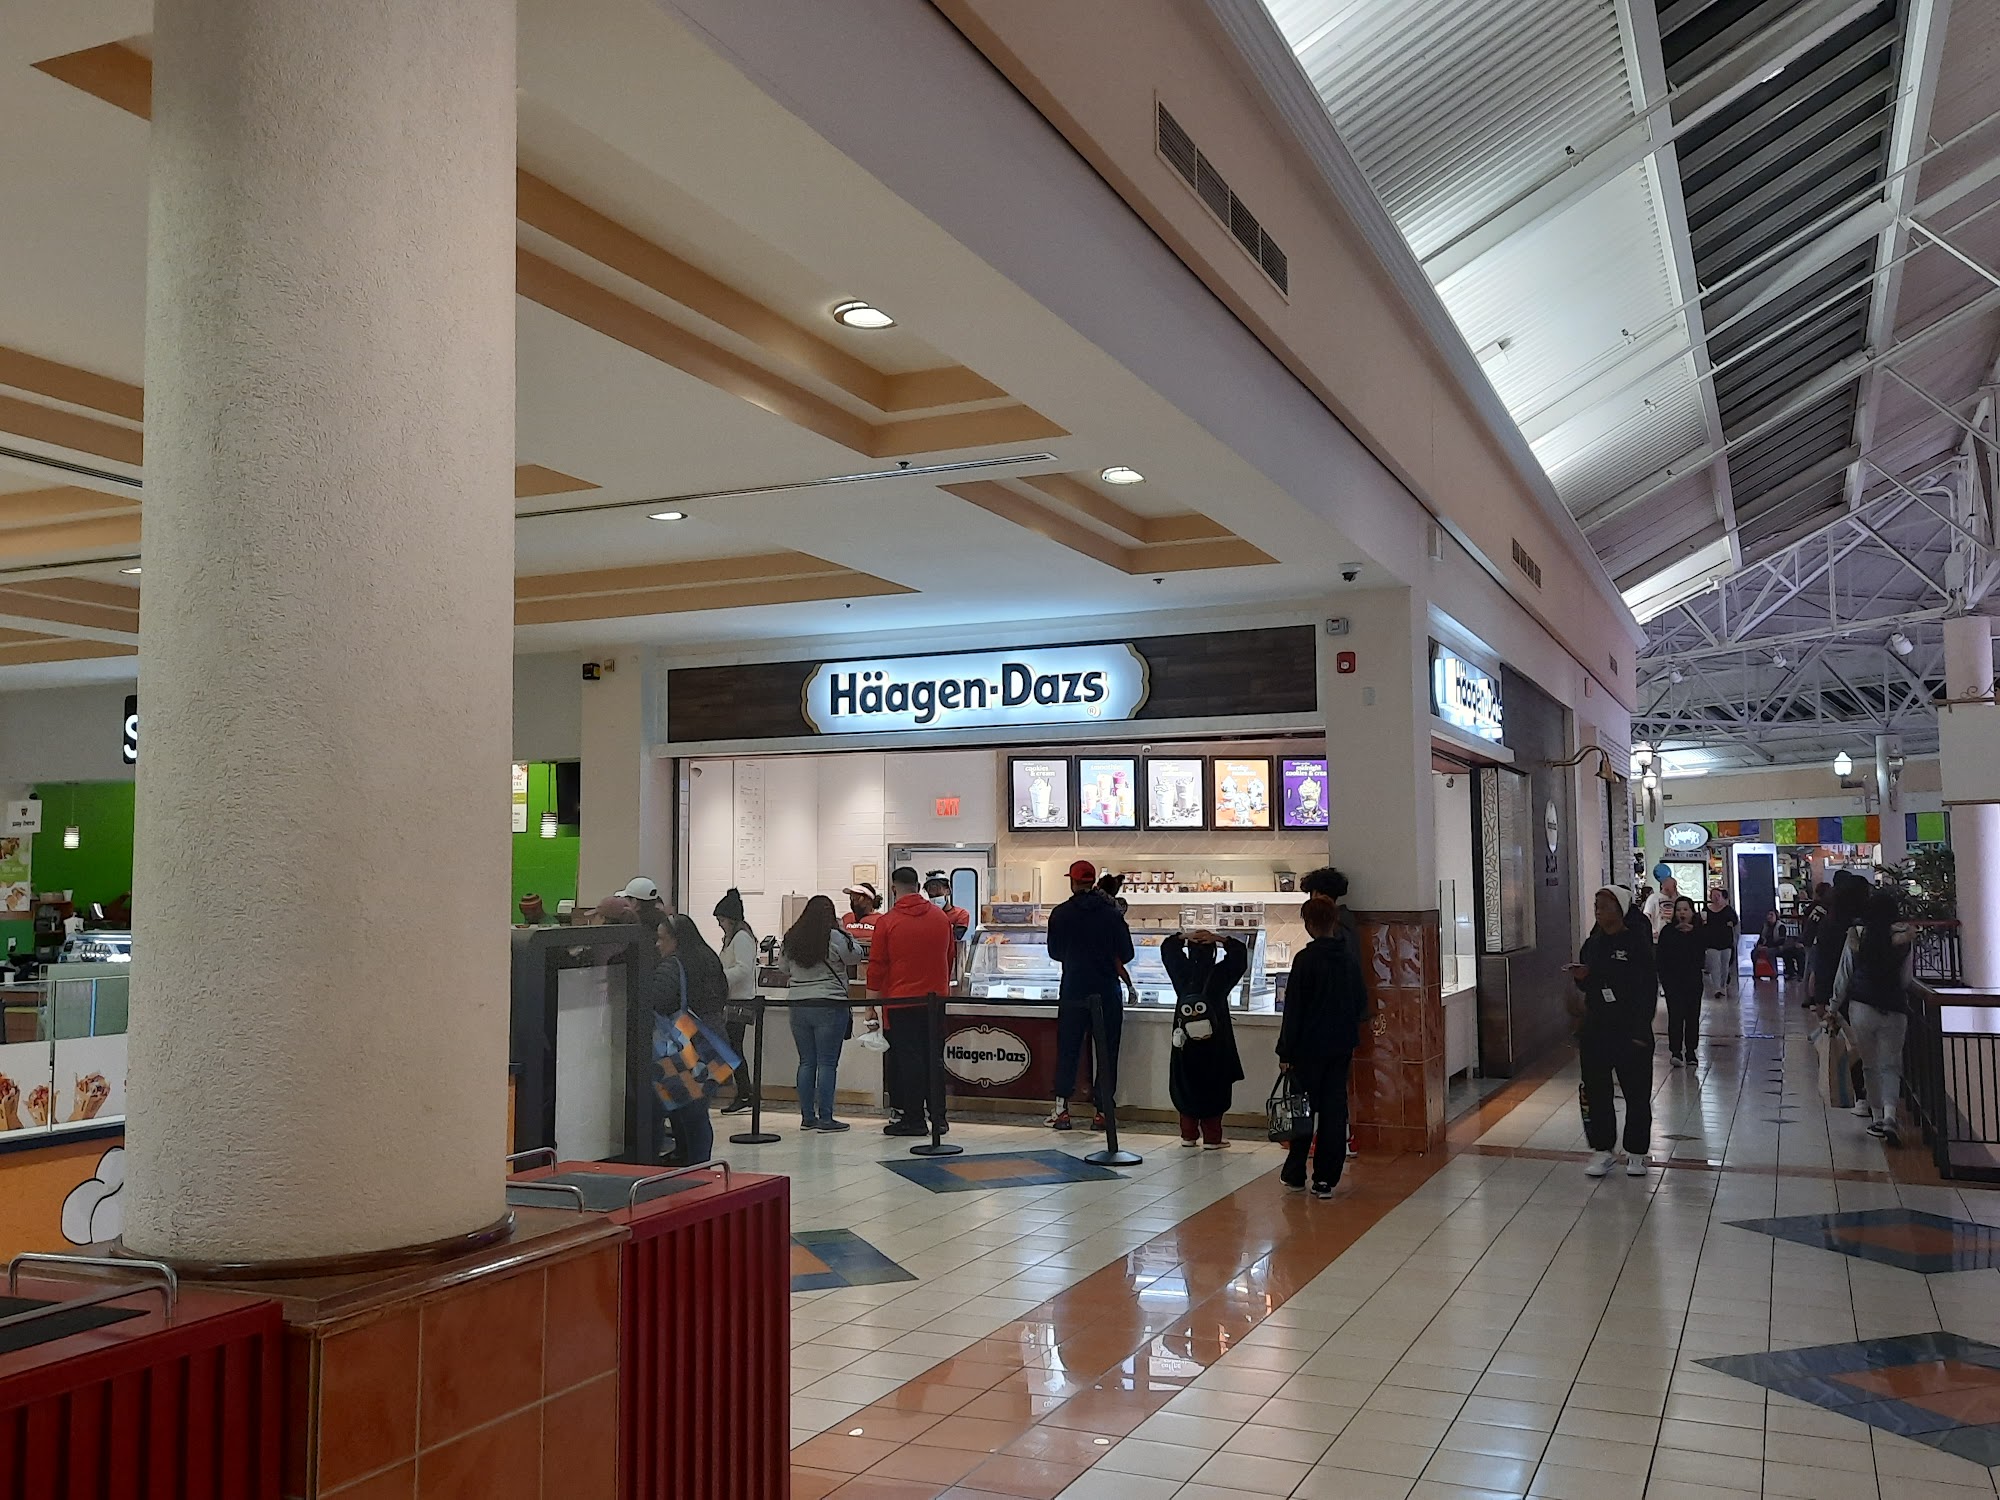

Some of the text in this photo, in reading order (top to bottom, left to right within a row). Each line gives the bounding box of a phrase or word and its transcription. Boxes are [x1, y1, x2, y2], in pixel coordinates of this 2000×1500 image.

[830, 663, 1106, 724] Häagen-Dazs
[935, 797, 961, 817] EXIT
[946, 1045, 1026, 1064] Häagen-Dazs
